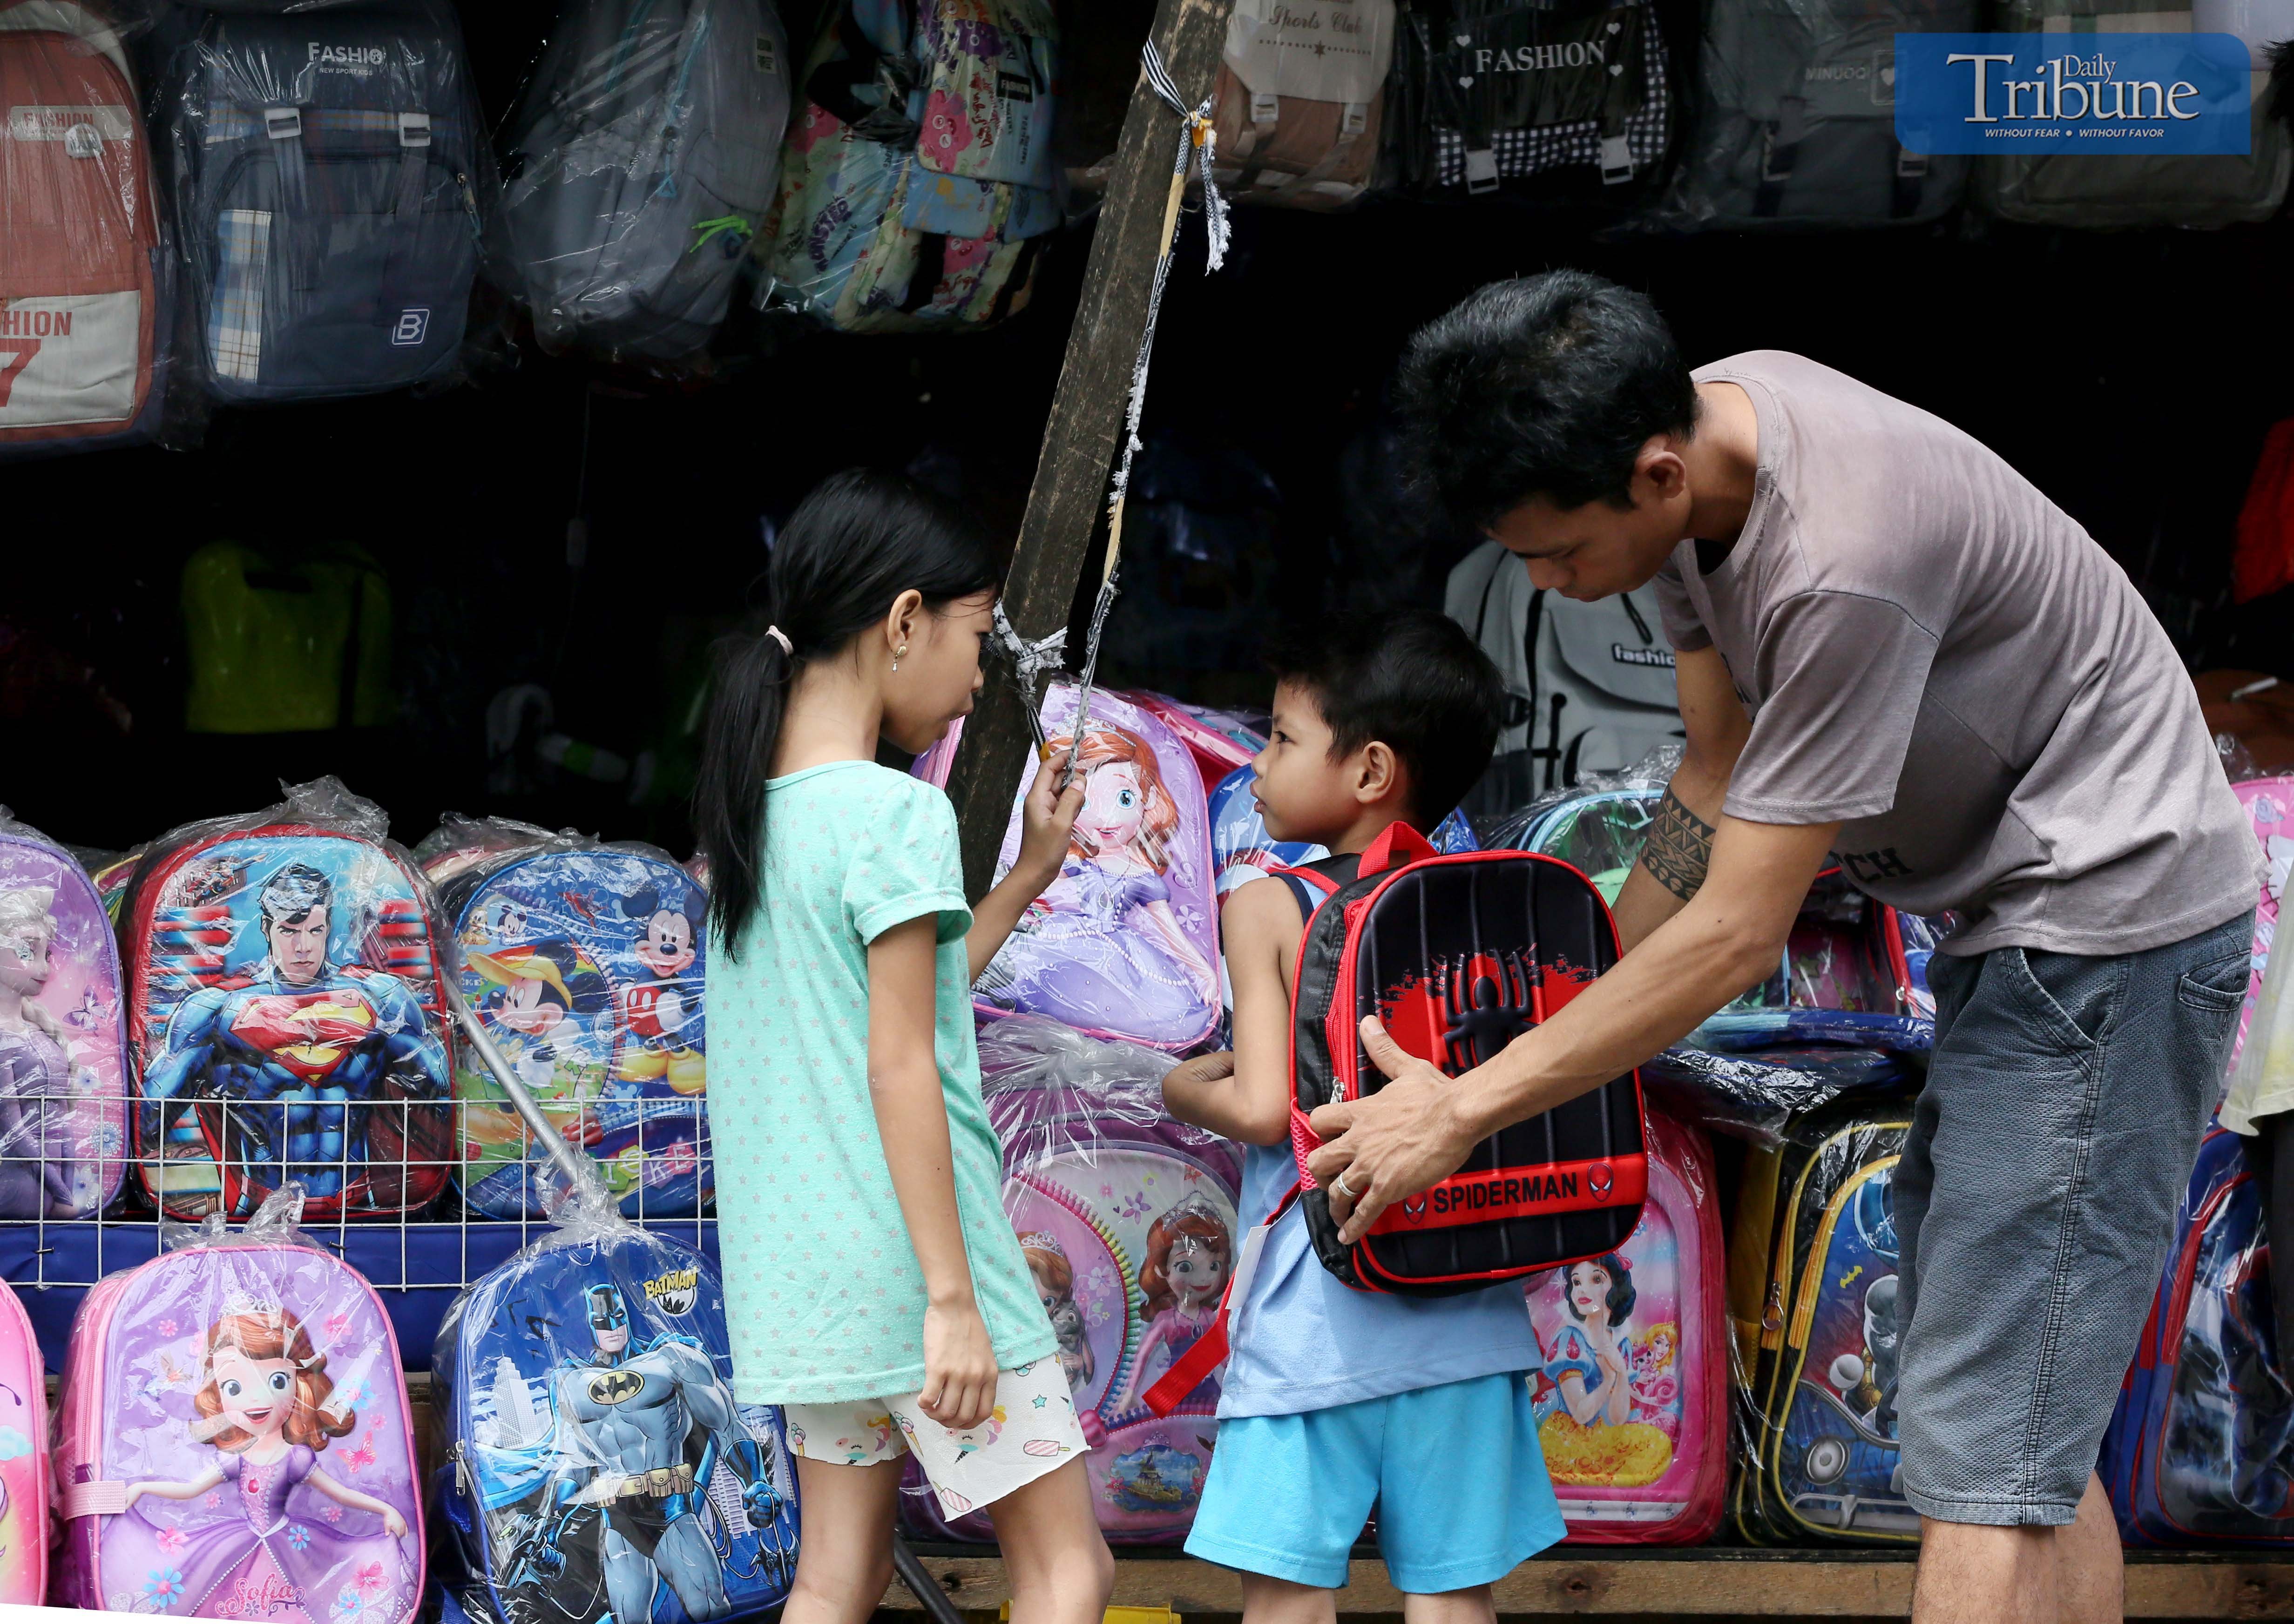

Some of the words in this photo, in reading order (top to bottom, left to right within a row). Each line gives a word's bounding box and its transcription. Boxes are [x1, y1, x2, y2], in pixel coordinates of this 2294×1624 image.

[1268, 5, 1320, 34] Sports
[1332, 11, 1361, 34] Club
[1475, 40, 1606, 73] FASHION
[1614, 645, 1676, 666] fashio
[605, 1146, 711, 1184] ICKEY
[1434, 1172, 1578, 1214] SPIDERMAN
[643, 1266, 698, 1300] BATMAN
[215, 1573, 305, 1617] Sofia
